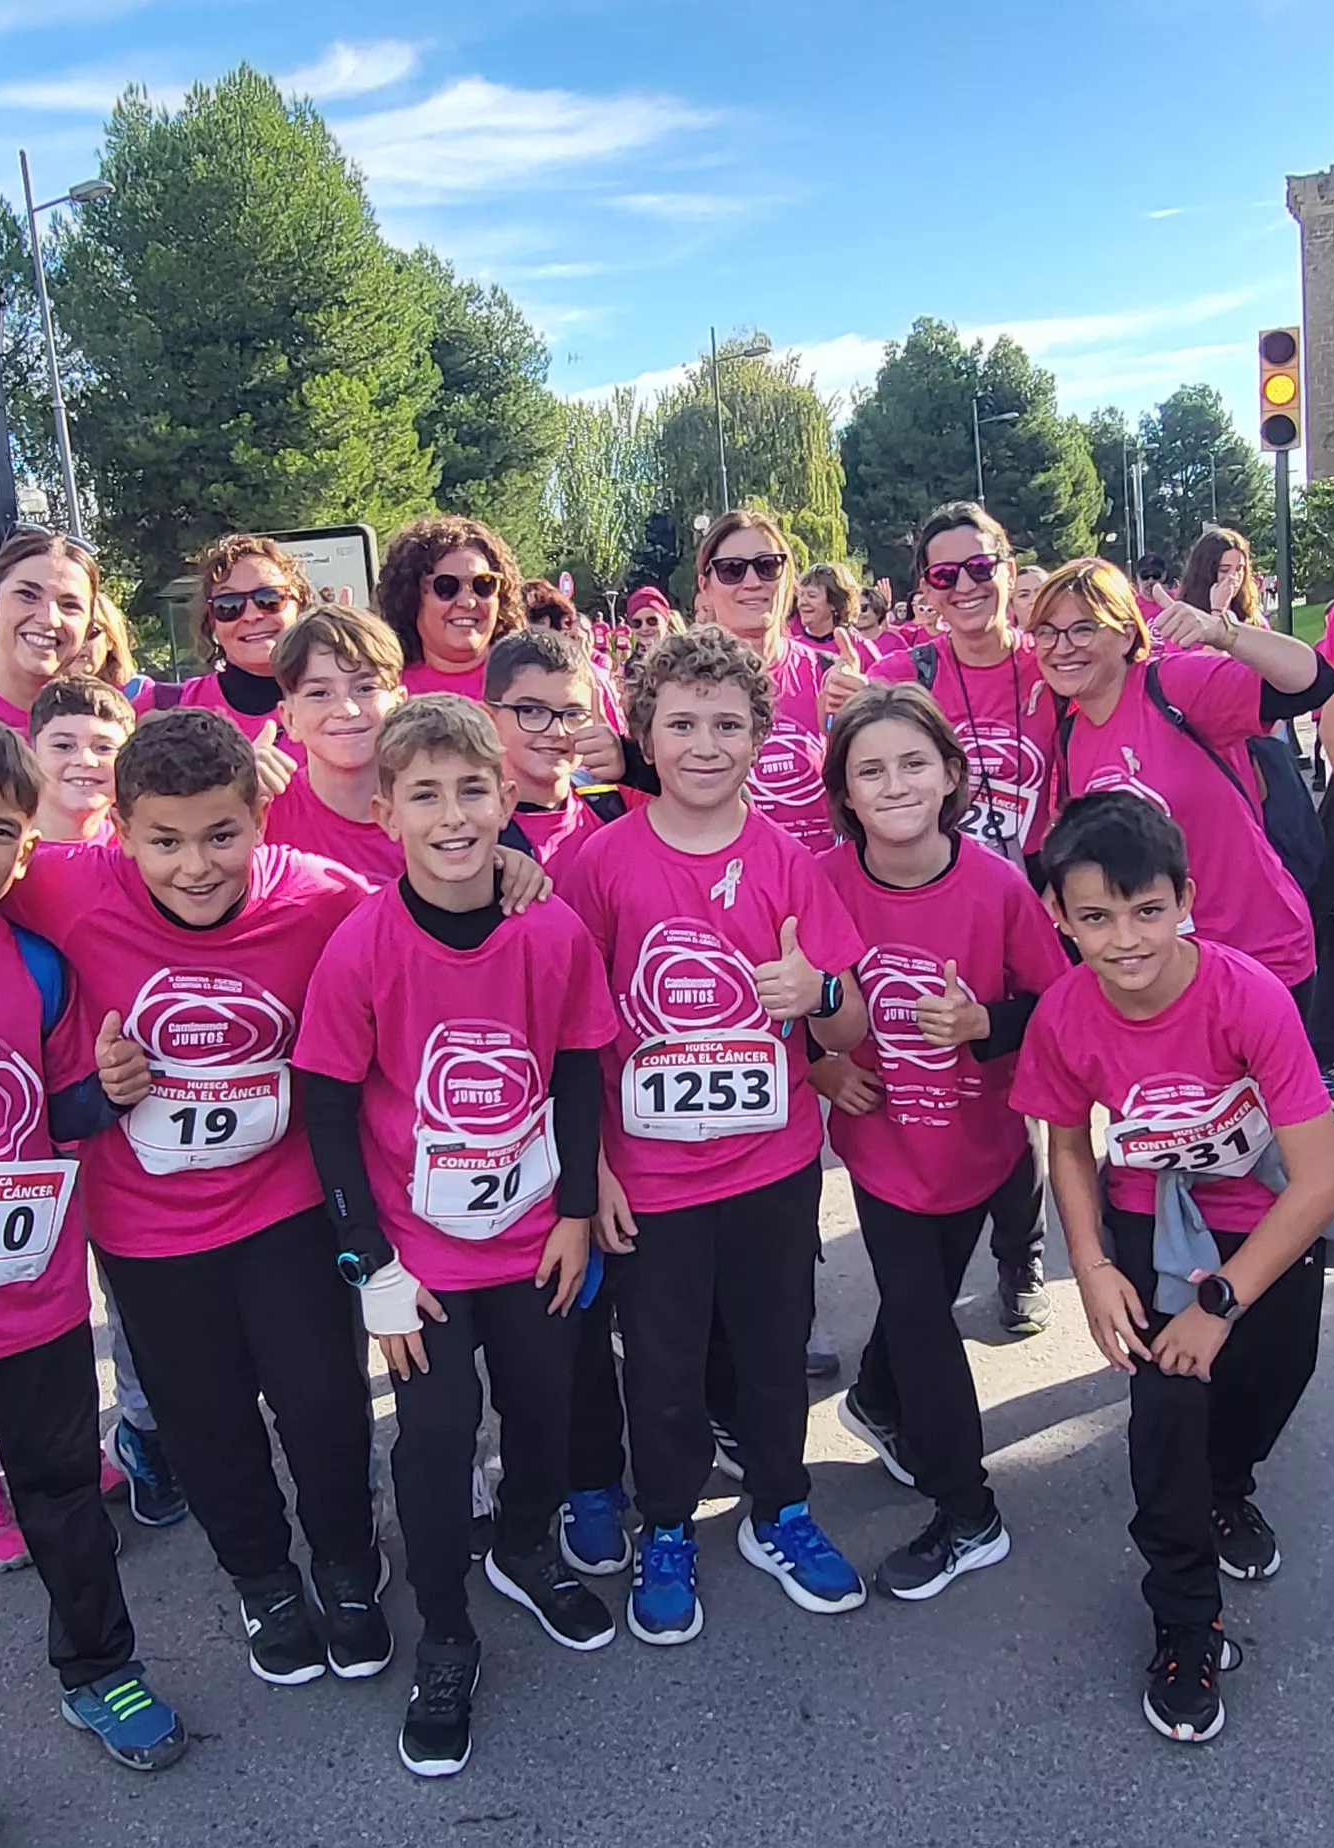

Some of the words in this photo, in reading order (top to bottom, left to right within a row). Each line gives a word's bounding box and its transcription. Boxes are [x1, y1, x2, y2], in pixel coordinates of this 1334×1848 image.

[668, 989, 715, 1004] JUNTOS
[883, 1008, 917, 1021] JUNTO
[171, 1032, 225, 1047] JUNTOS
[685, 1043, 724, 1052] HUESCA
[641, 1051, 696, 1066] CONTRA
[698, 1053, 713, 1063] EL
[716, 1048, 769, 1063] CÁNCER
[149, 1085, 197, 1101] ONTRA
[200, 1091, 216, 1101] EL
[219, 1084, 271, 1101] CÁNCER
[186, 1081, 229, 1091] HUESCA
[641, 1069, 771, 1113] 1253
[452, 1089, 502, 1104] JUNTOS
[169, 1107, 238, 1145] 19
[1128, 1138, 1187, 1152] CONTRA
[1189, 1132, 1205, 1142] EL
[1149, 1127, 1251, 1171] 231
[437, 1156, 496, 1169] CONTRA
[499, 1155, 512, 1167] EL
[2, 1183, 55, 1199] CÁNCER
[466, 1162, 521, 1212] 20
